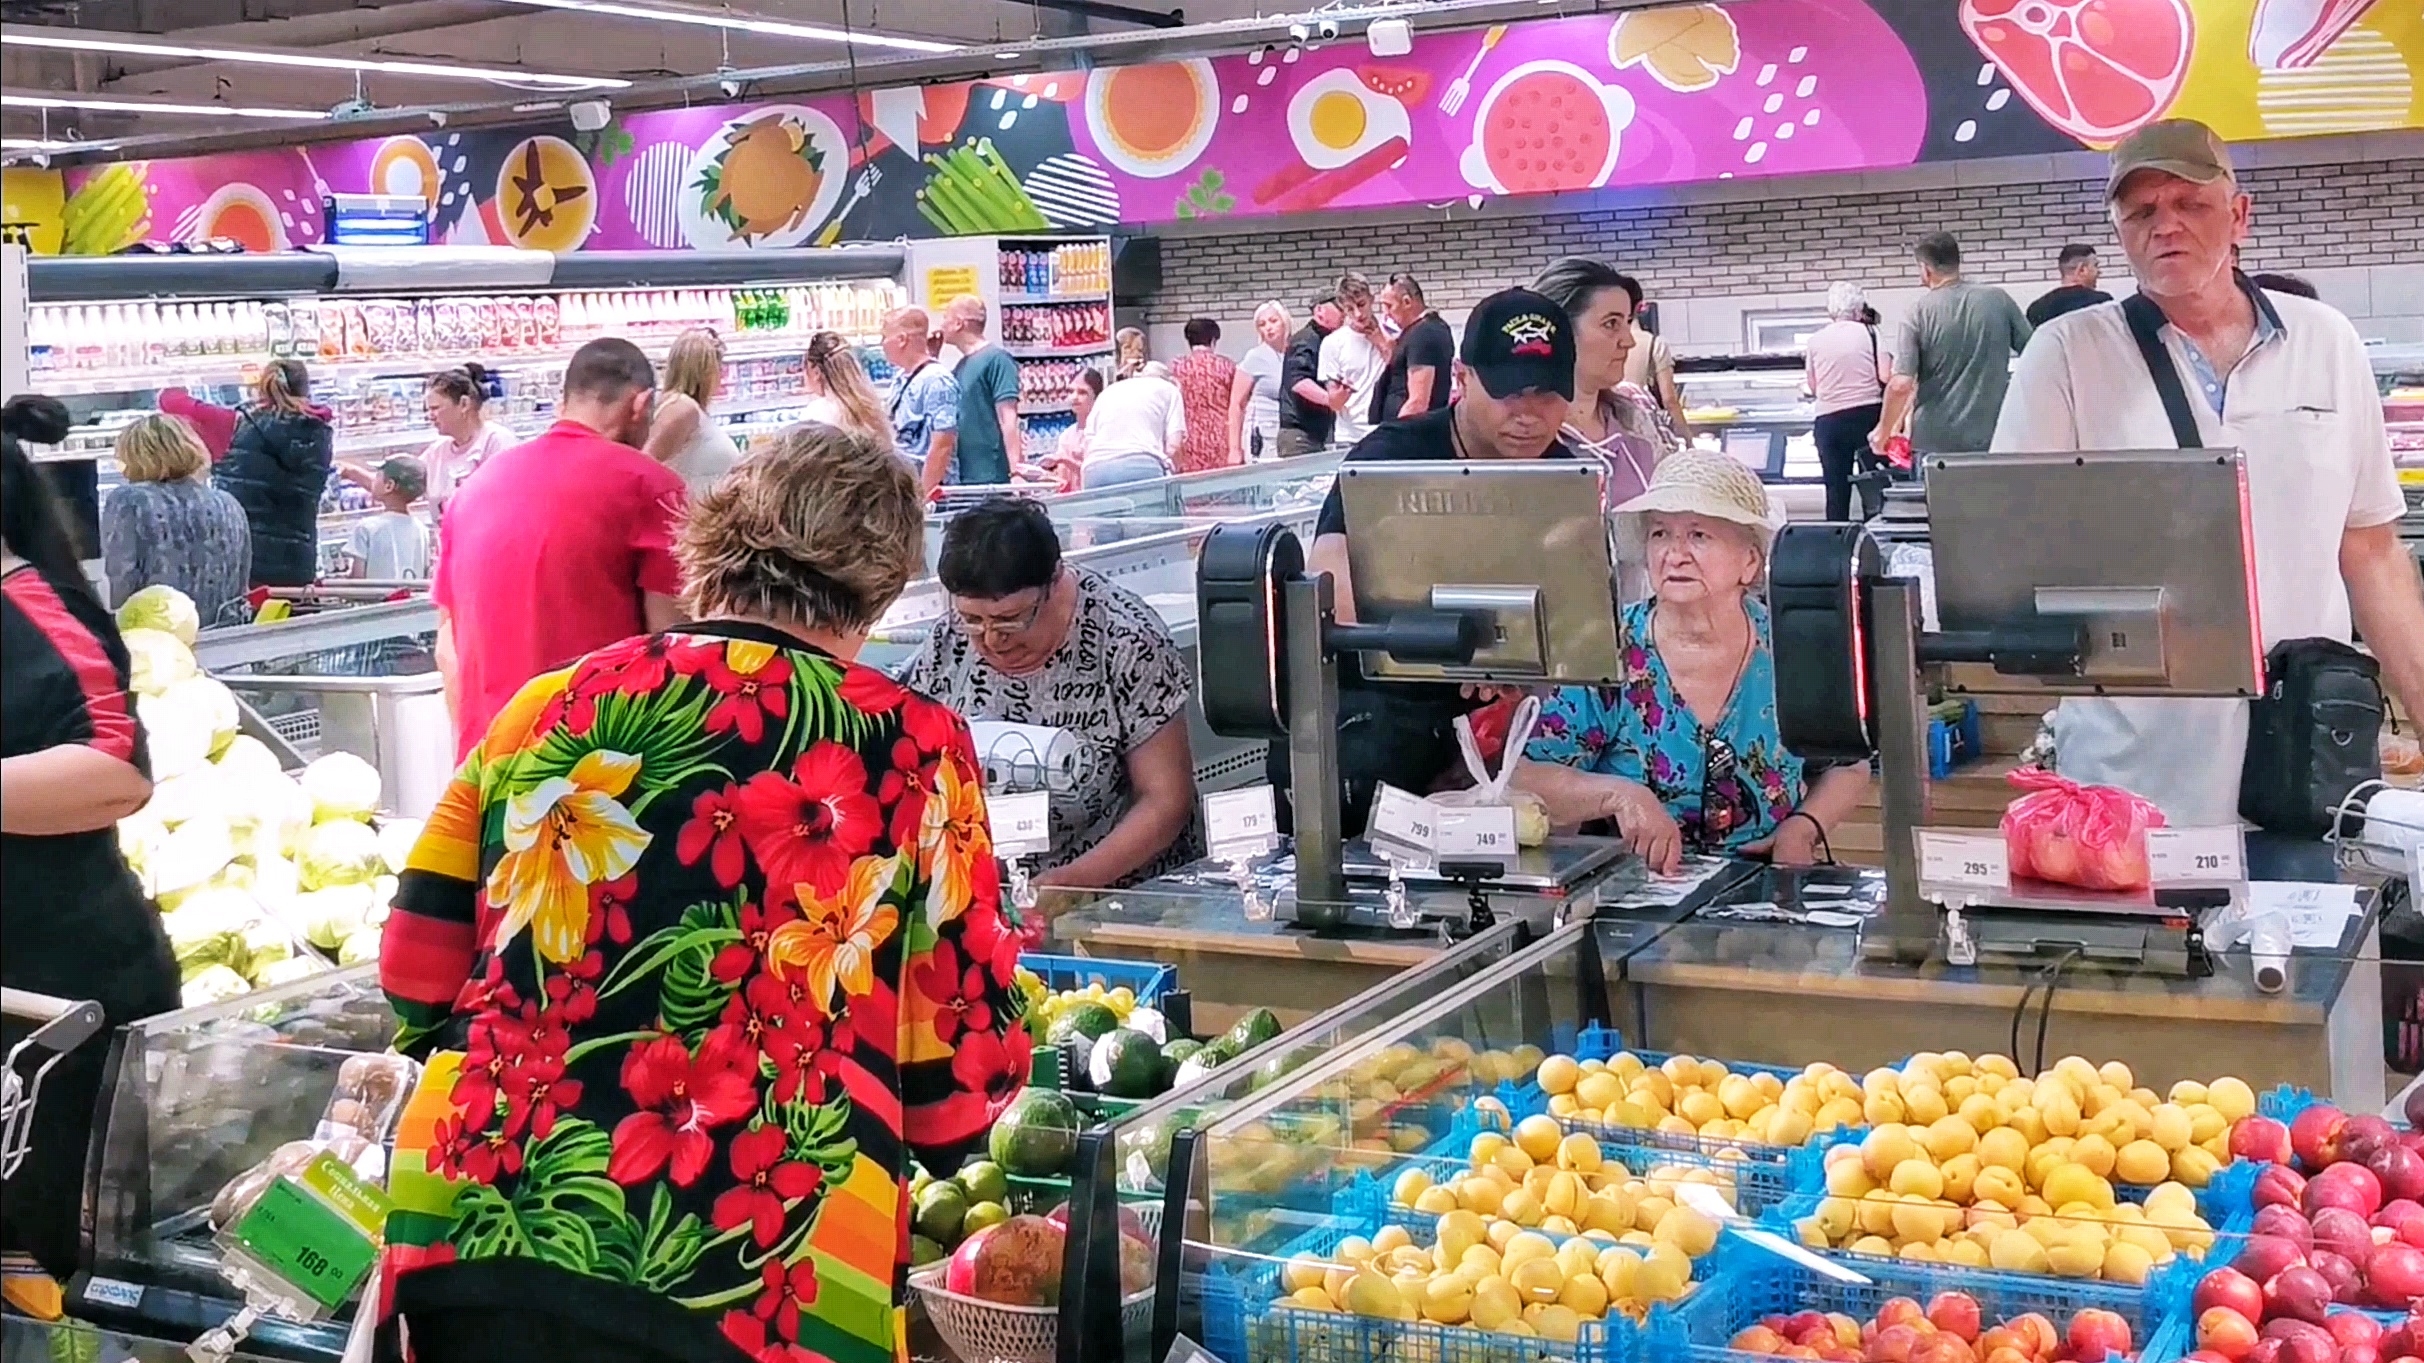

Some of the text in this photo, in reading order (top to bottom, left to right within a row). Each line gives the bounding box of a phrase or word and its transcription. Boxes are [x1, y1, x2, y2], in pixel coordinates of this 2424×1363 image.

[1410, 821, 1430, 837] 799
[1476, 833, 1496, 846] 749
[1964, 862, 1988, 875] 295
[2195, 855, 2219, 869] 210
[295, 1246, 329, 1278] 168
